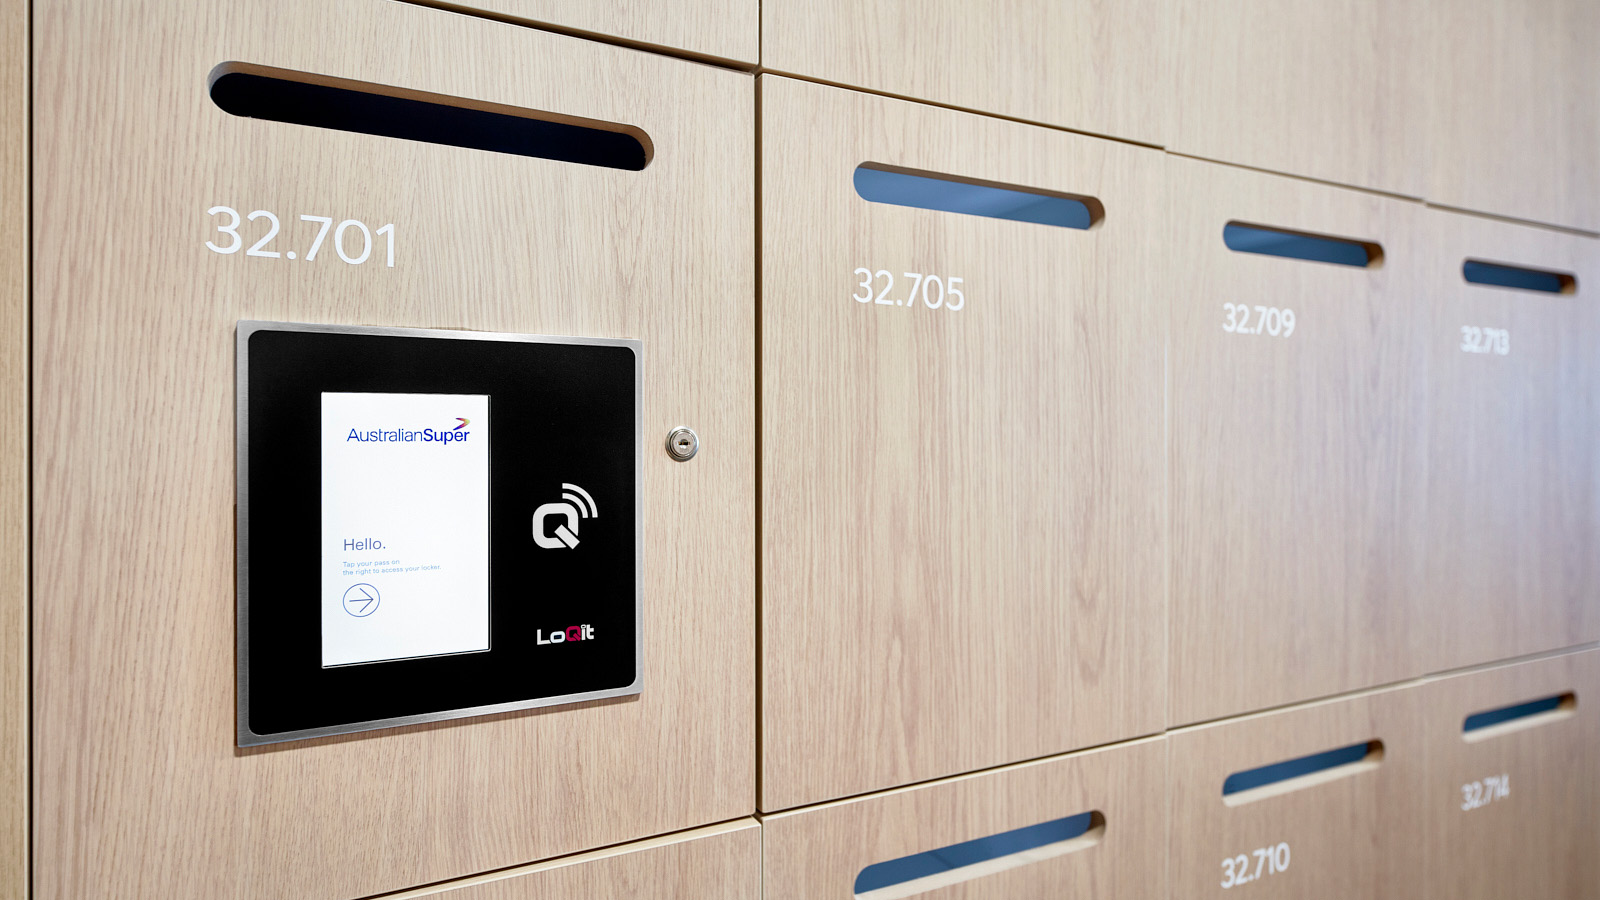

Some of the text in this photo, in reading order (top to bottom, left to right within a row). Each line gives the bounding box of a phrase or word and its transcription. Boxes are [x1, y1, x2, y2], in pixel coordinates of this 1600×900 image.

[205, 205, 395, 268] 32.701
[853, 267, 965, 312] 32.705
[1222, 302, 1296, 338] 32.709
[346, 428, 471, 445] AustralianSuper
[343, 537, 386, 551] Hello.
[355, 568, 371, 576] right
[357, 560, 372, 568] your
[1220, 841, 1291, 889] 32.710
